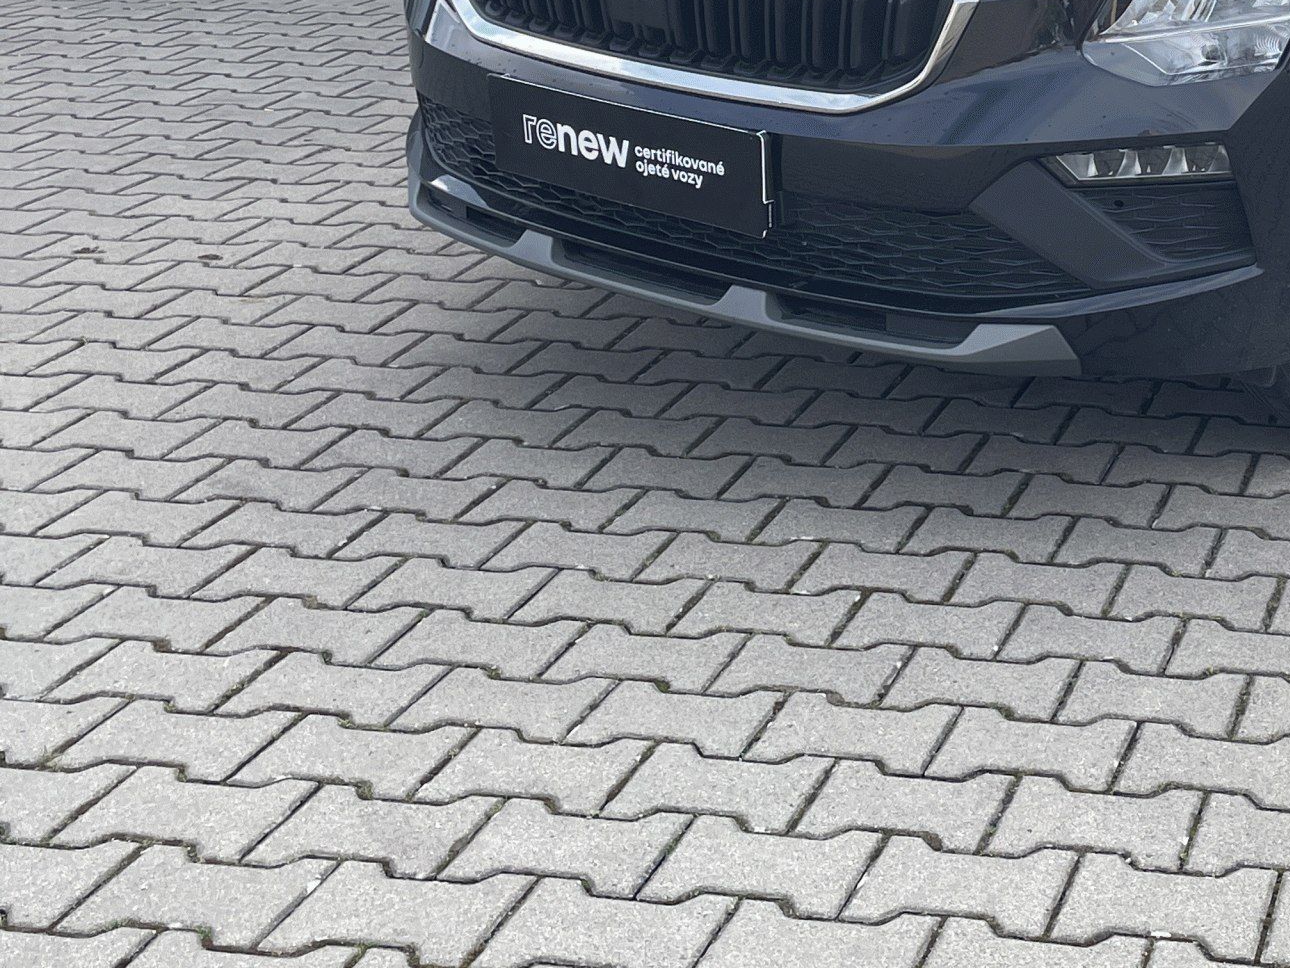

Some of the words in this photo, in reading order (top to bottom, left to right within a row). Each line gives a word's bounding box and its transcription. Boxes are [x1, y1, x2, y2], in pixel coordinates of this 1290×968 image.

[522, 114, 630, 169] renew
[634, 145, 726, 177] certifikované
[635, 159, 670, 178] ojeté
[671, 168, 704, 188] vozy
